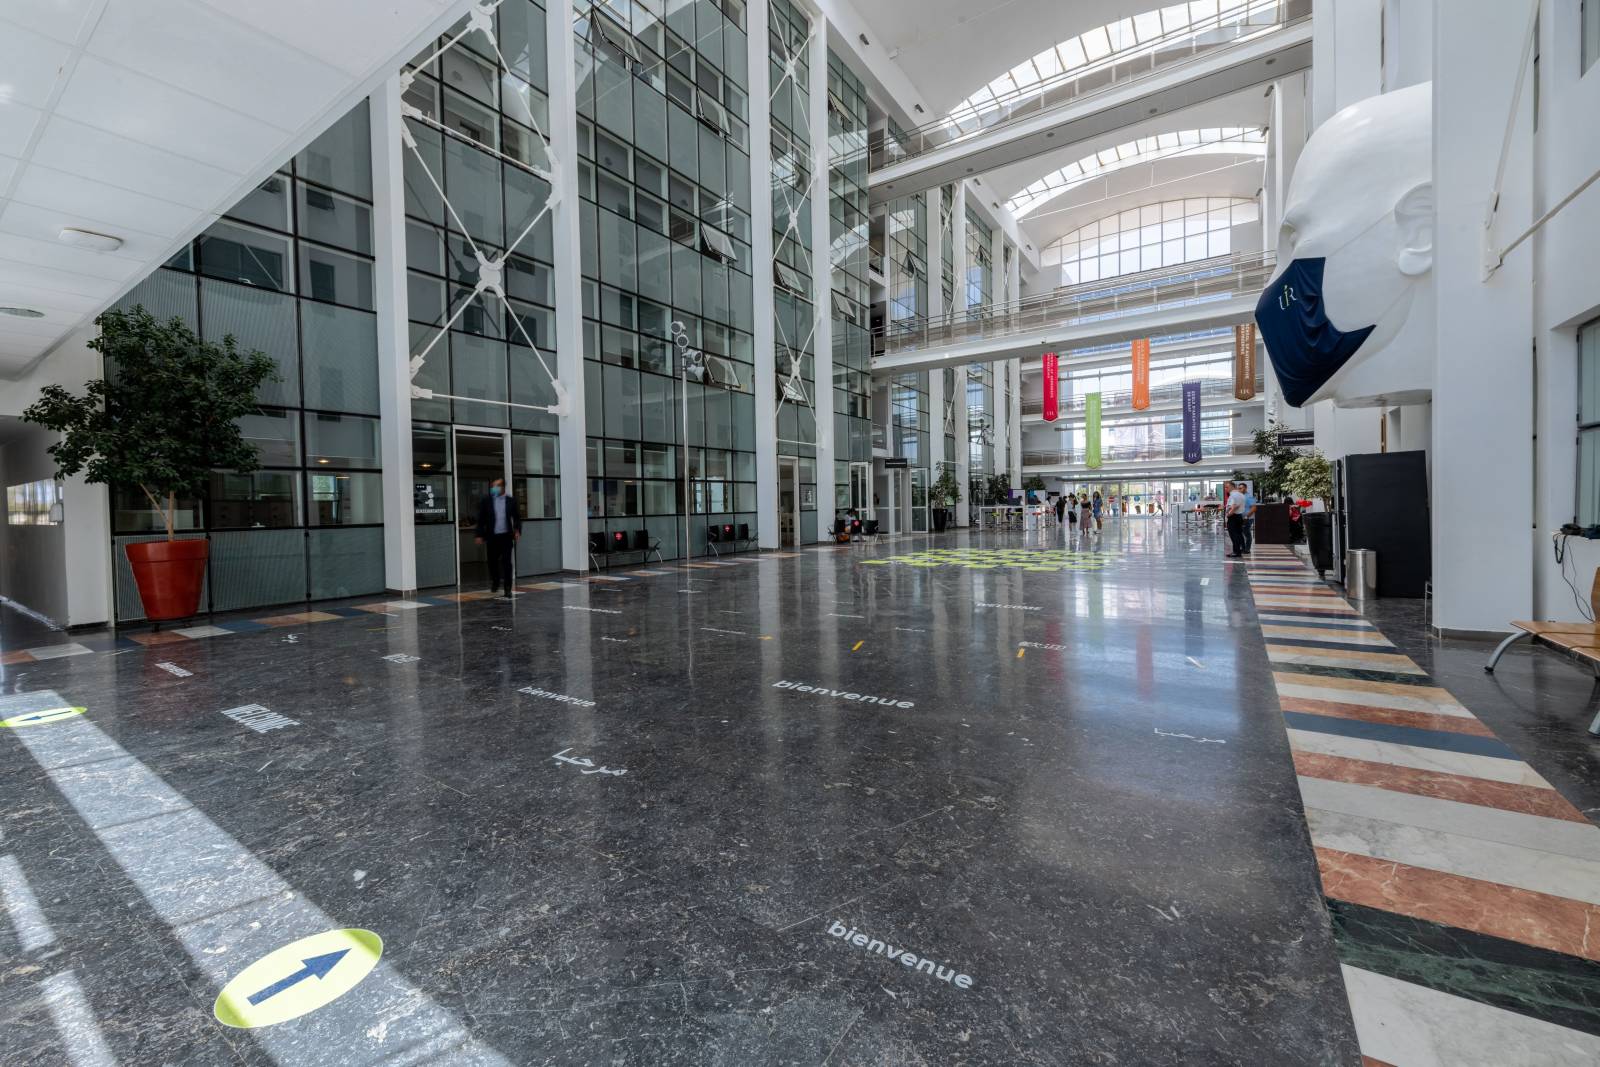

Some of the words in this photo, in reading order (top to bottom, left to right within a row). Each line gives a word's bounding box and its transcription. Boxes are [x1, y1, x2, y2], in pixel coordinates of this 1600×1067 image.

[516, 686, 597, 707] bienvenue
[772, 680, 915, 709] bienvenue
[552, 747, 629, 776] مرحبا
[827, 920, 973, 989] bienvenue
